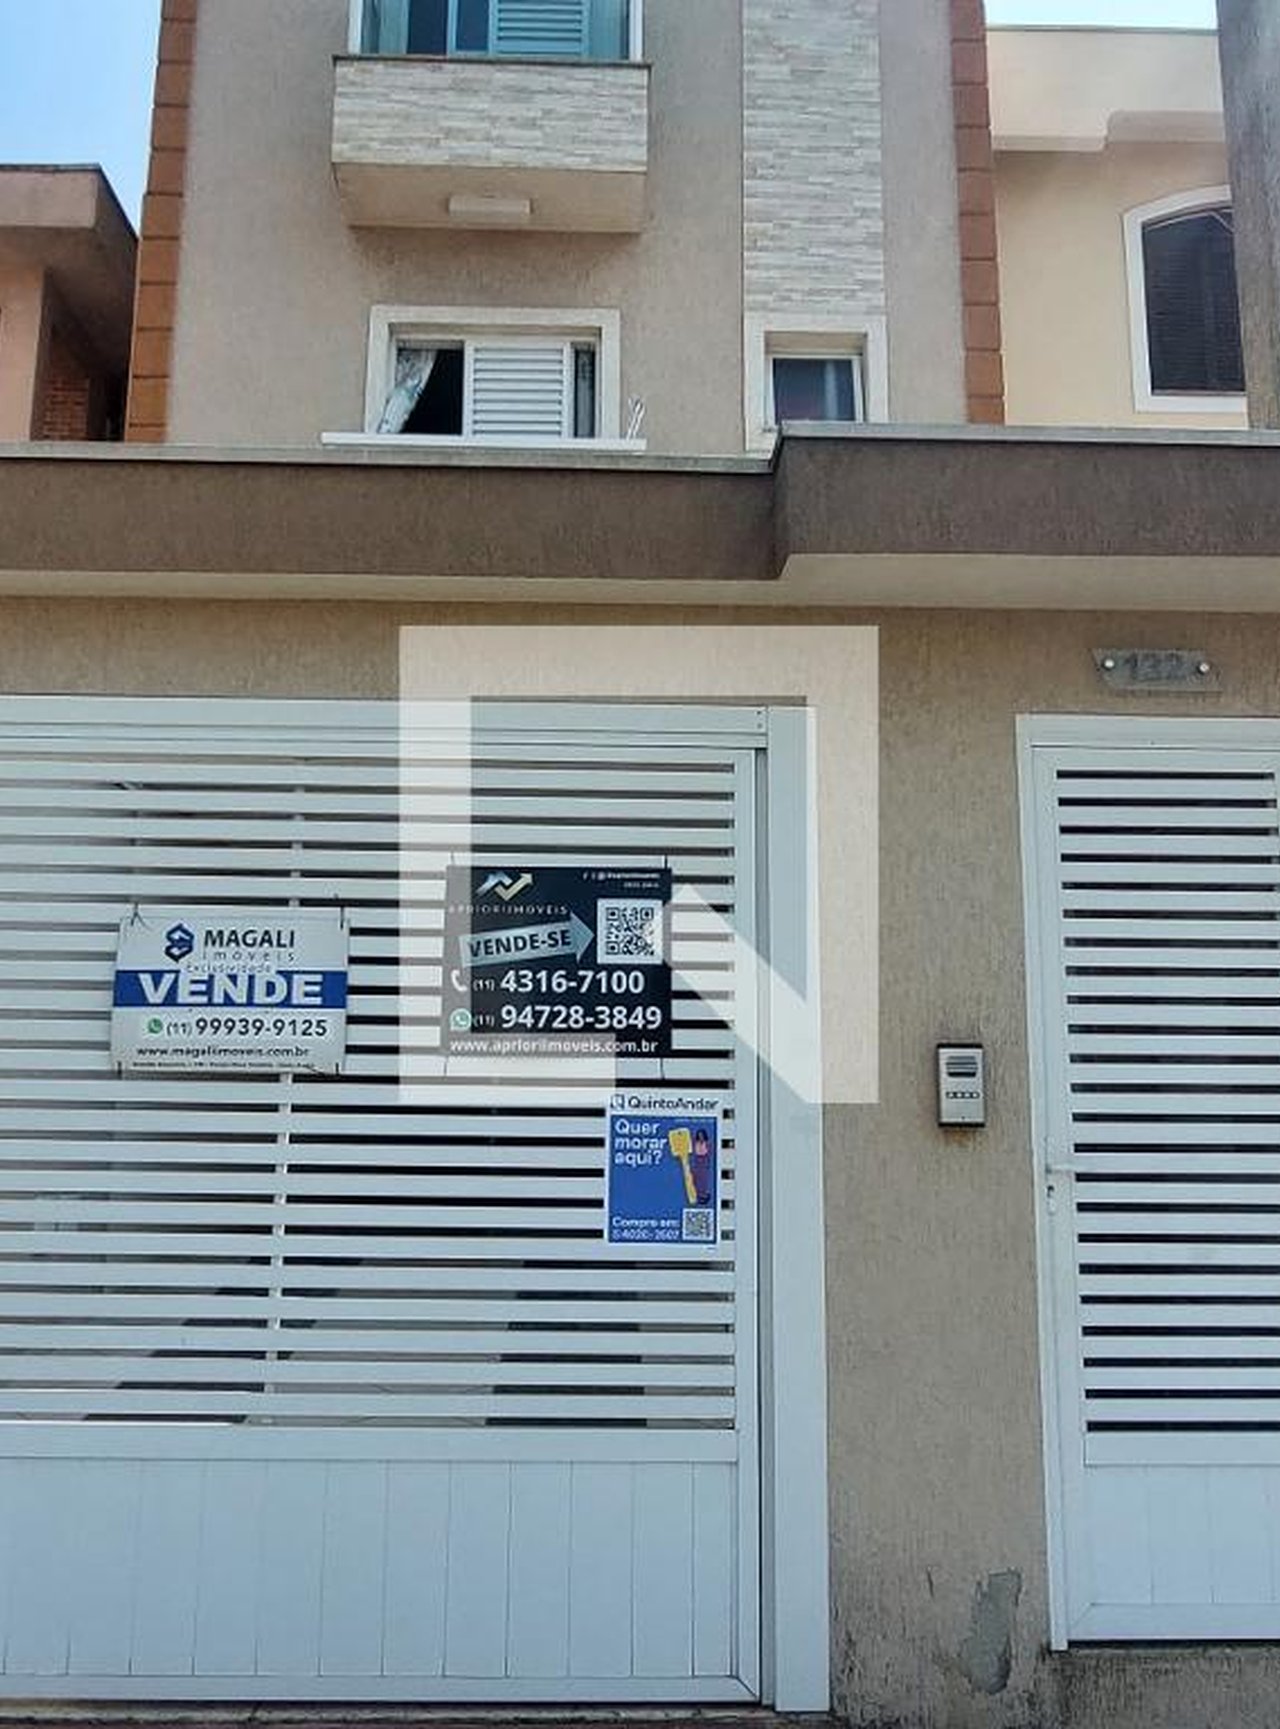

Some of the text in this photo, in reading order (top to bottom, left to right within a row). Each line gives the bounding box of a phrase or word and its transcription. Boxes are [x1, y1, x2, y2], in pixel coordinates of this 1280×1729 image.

[203, 929, 295, 948] MAGALI
[469, 929, 572, 958] VENDE-SE
[138, 973, 324, 1006] VENDE
[472, 969, 645, 994] (11) 4316-7100
[472, 1004, 663, 1029] (11) 94728-3849
[166, 1017, 328, 1037] (11) 99939-9125
[627, 1095, 720, 1111] QuintoAndar
[614, 1118, 661, 1135] Quer
[614, 1137, 668, 1150] morar
[614, 1150, 663, 1167] aqui?
